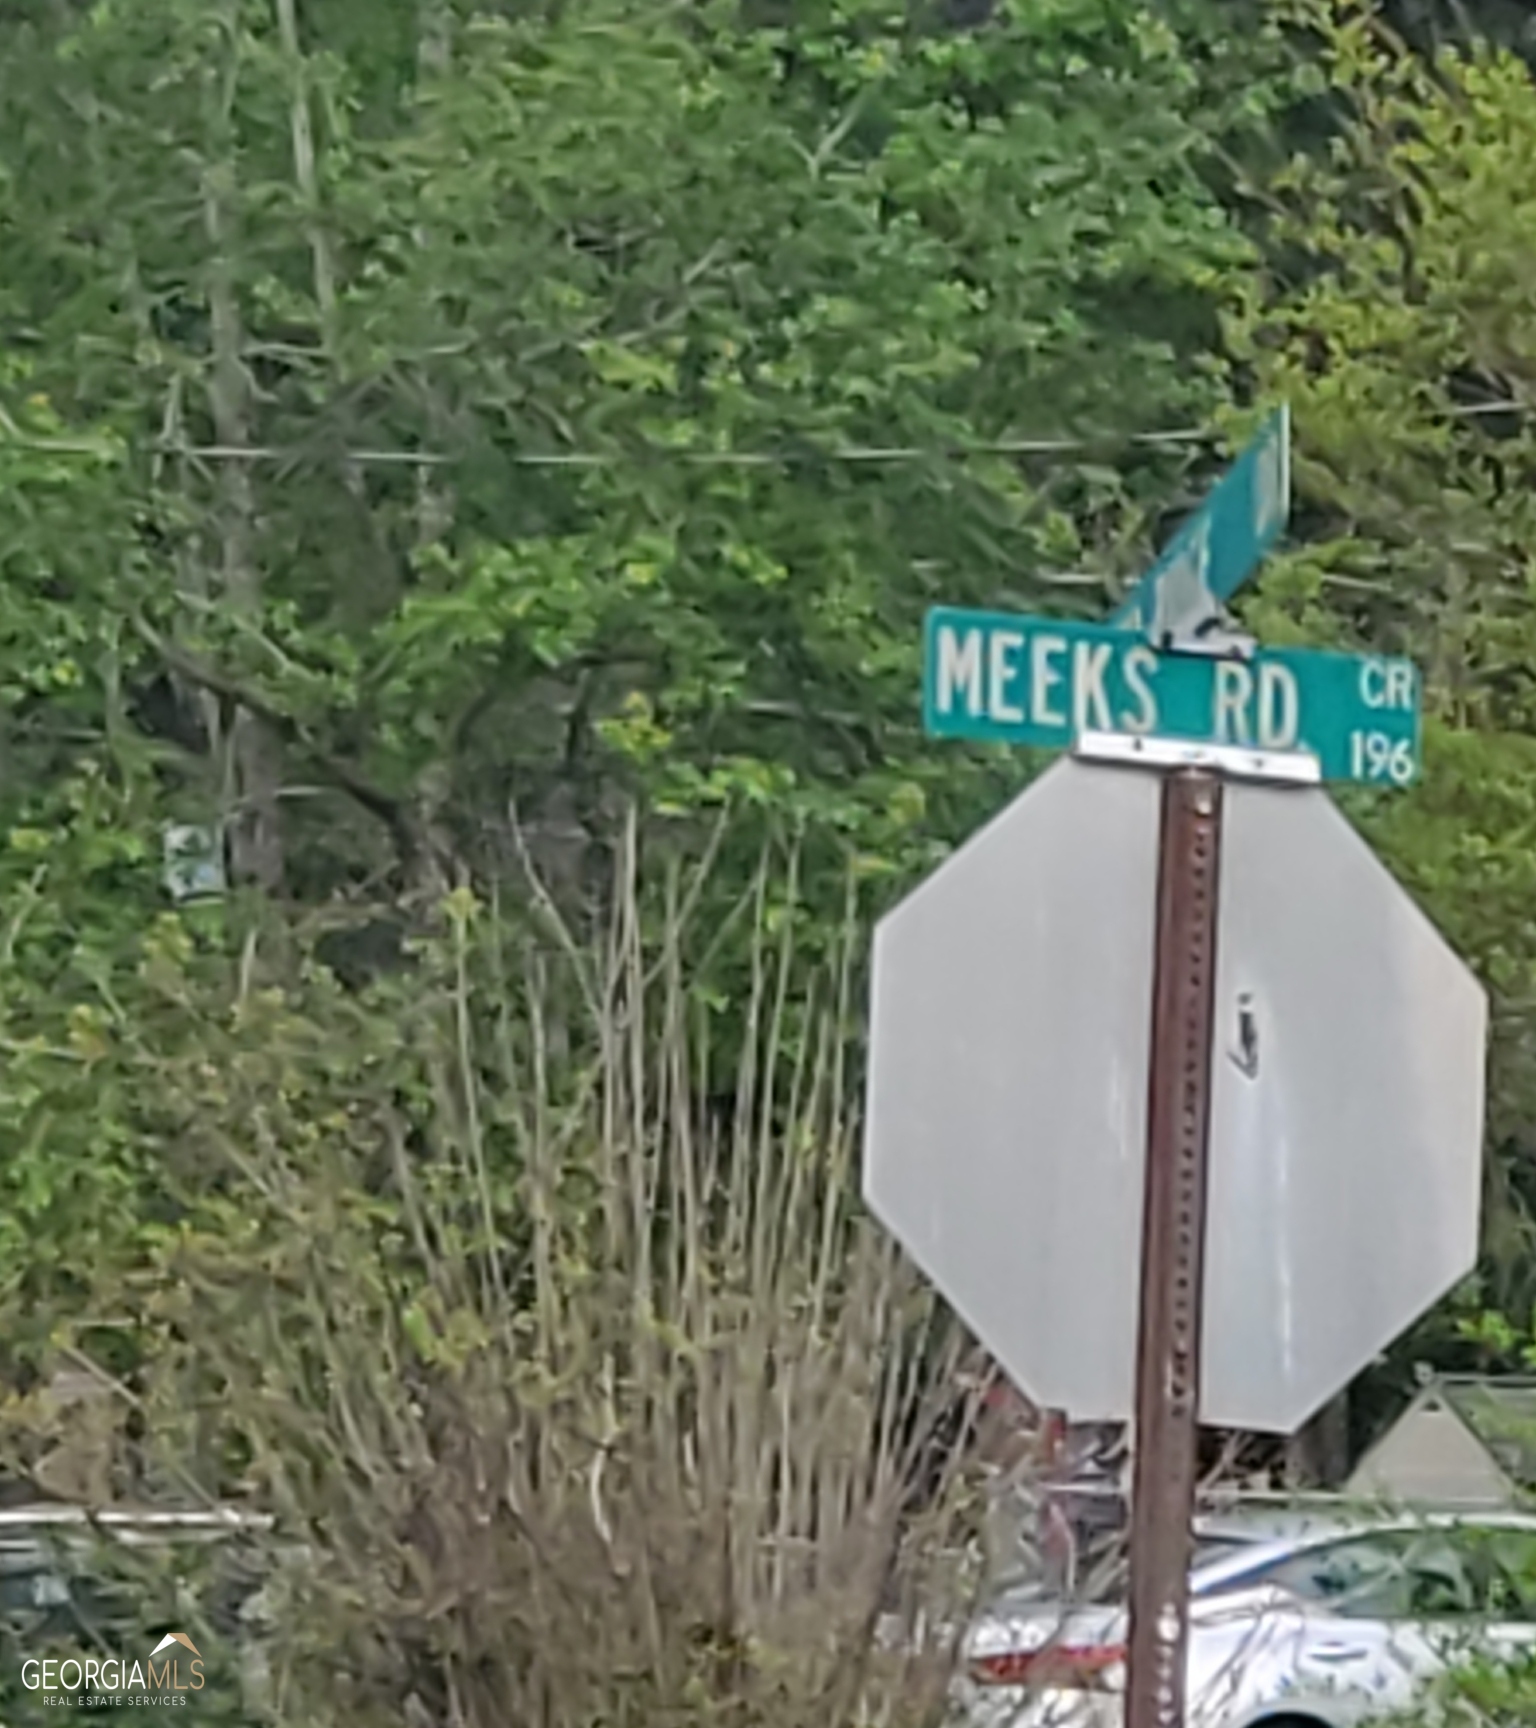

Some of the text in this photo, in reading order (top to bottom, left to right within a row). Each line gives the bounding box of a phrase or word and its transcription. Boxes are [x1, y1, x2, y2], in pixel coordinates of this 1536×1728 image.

[936, 626, 1299, 748] MEEKS RD
[1359, 660, 1413, 710] CR
[1350, 730, 1412, 782] 196
